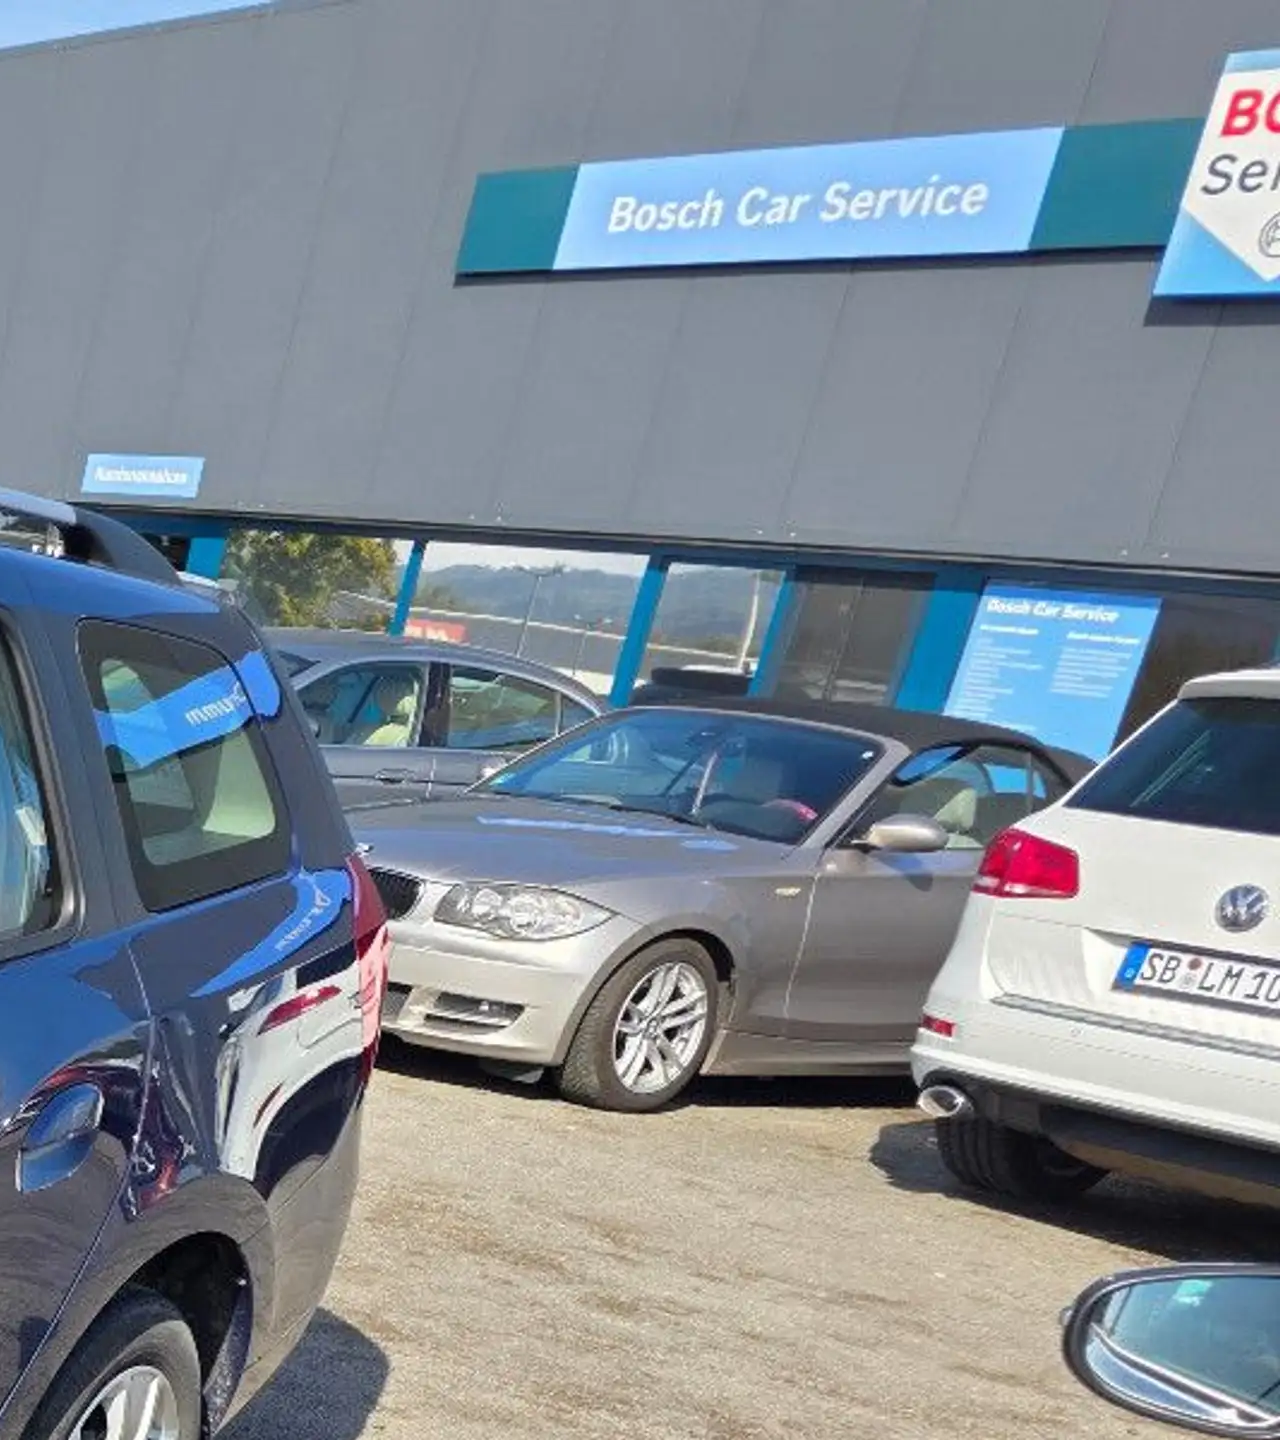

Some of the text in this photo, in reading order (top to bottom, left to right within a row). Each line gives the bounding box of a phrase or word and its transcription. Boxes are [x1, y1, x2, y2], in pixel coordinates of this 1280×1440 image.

[607, 174, 990, 233] Bosch Car Service
[987, 598, 1030, 614] Bosch
[1141, 953, 1181, 984] SB
[1197, 962, 1246, 996] LM
